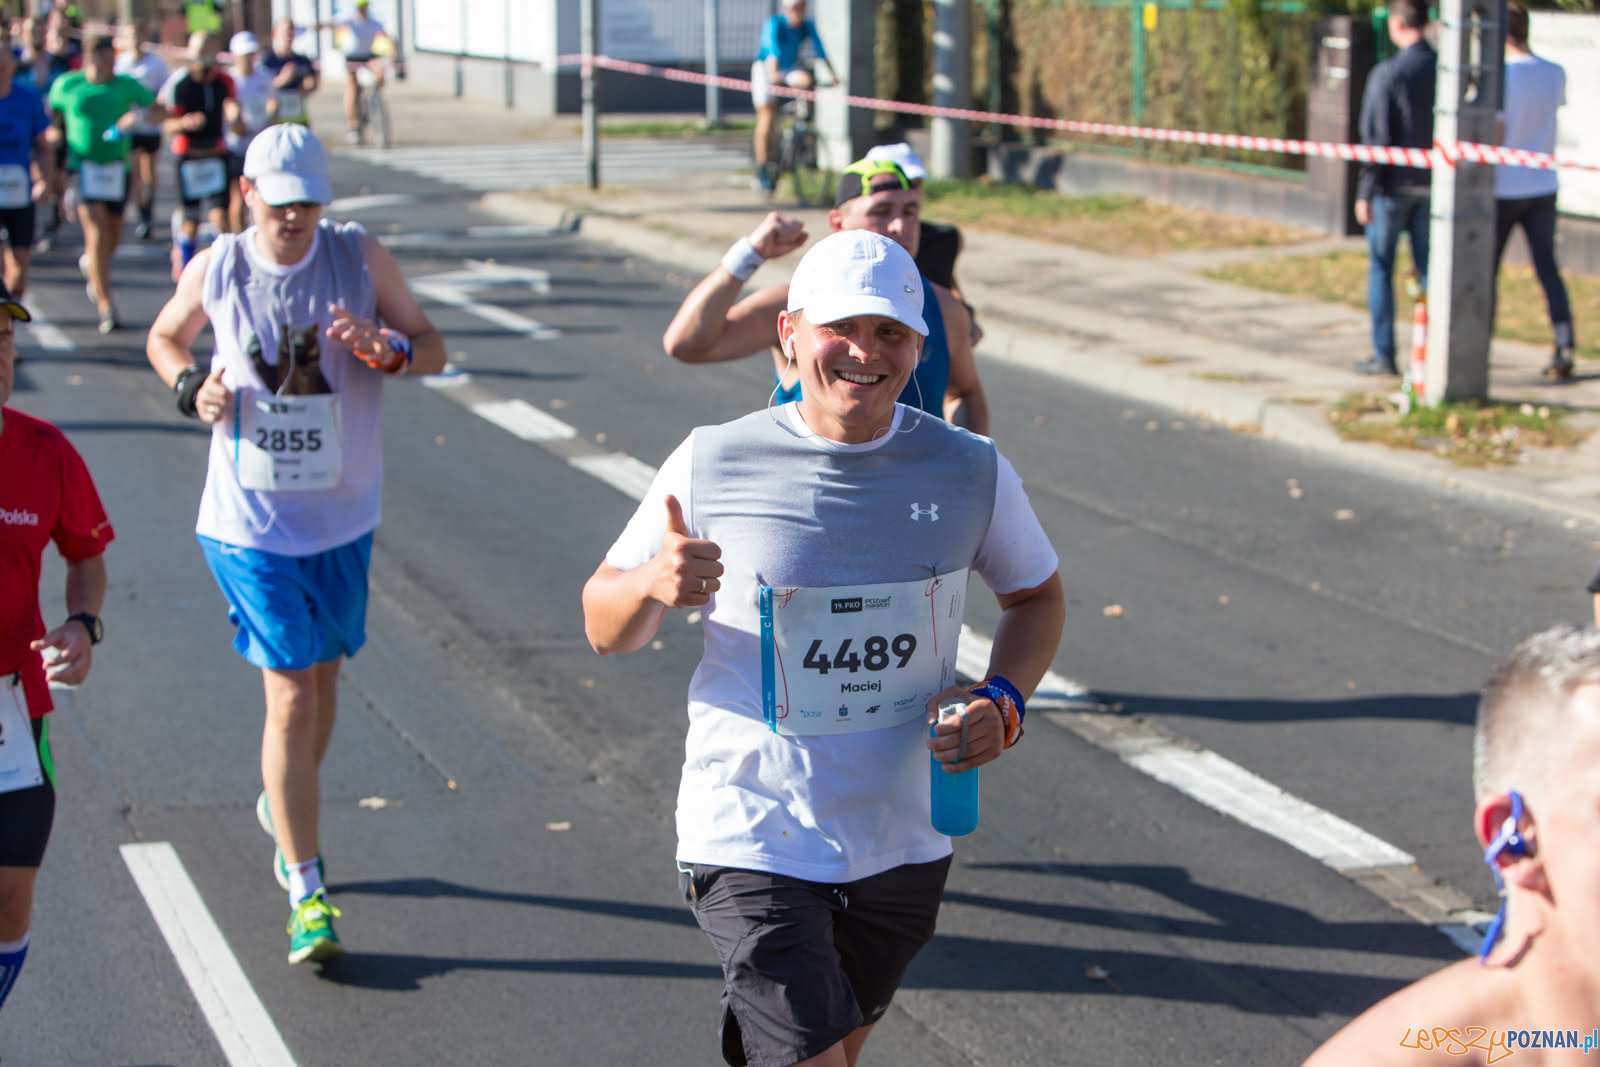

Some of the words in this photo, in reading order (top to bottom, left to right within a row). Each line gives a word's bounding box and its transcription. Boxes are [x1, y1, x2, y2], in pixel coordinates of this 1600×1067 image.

[256, 427, 322, 453] 2855
[803, 633, 917, 675] 4489
[840, 680, 882, 694] Maciej
